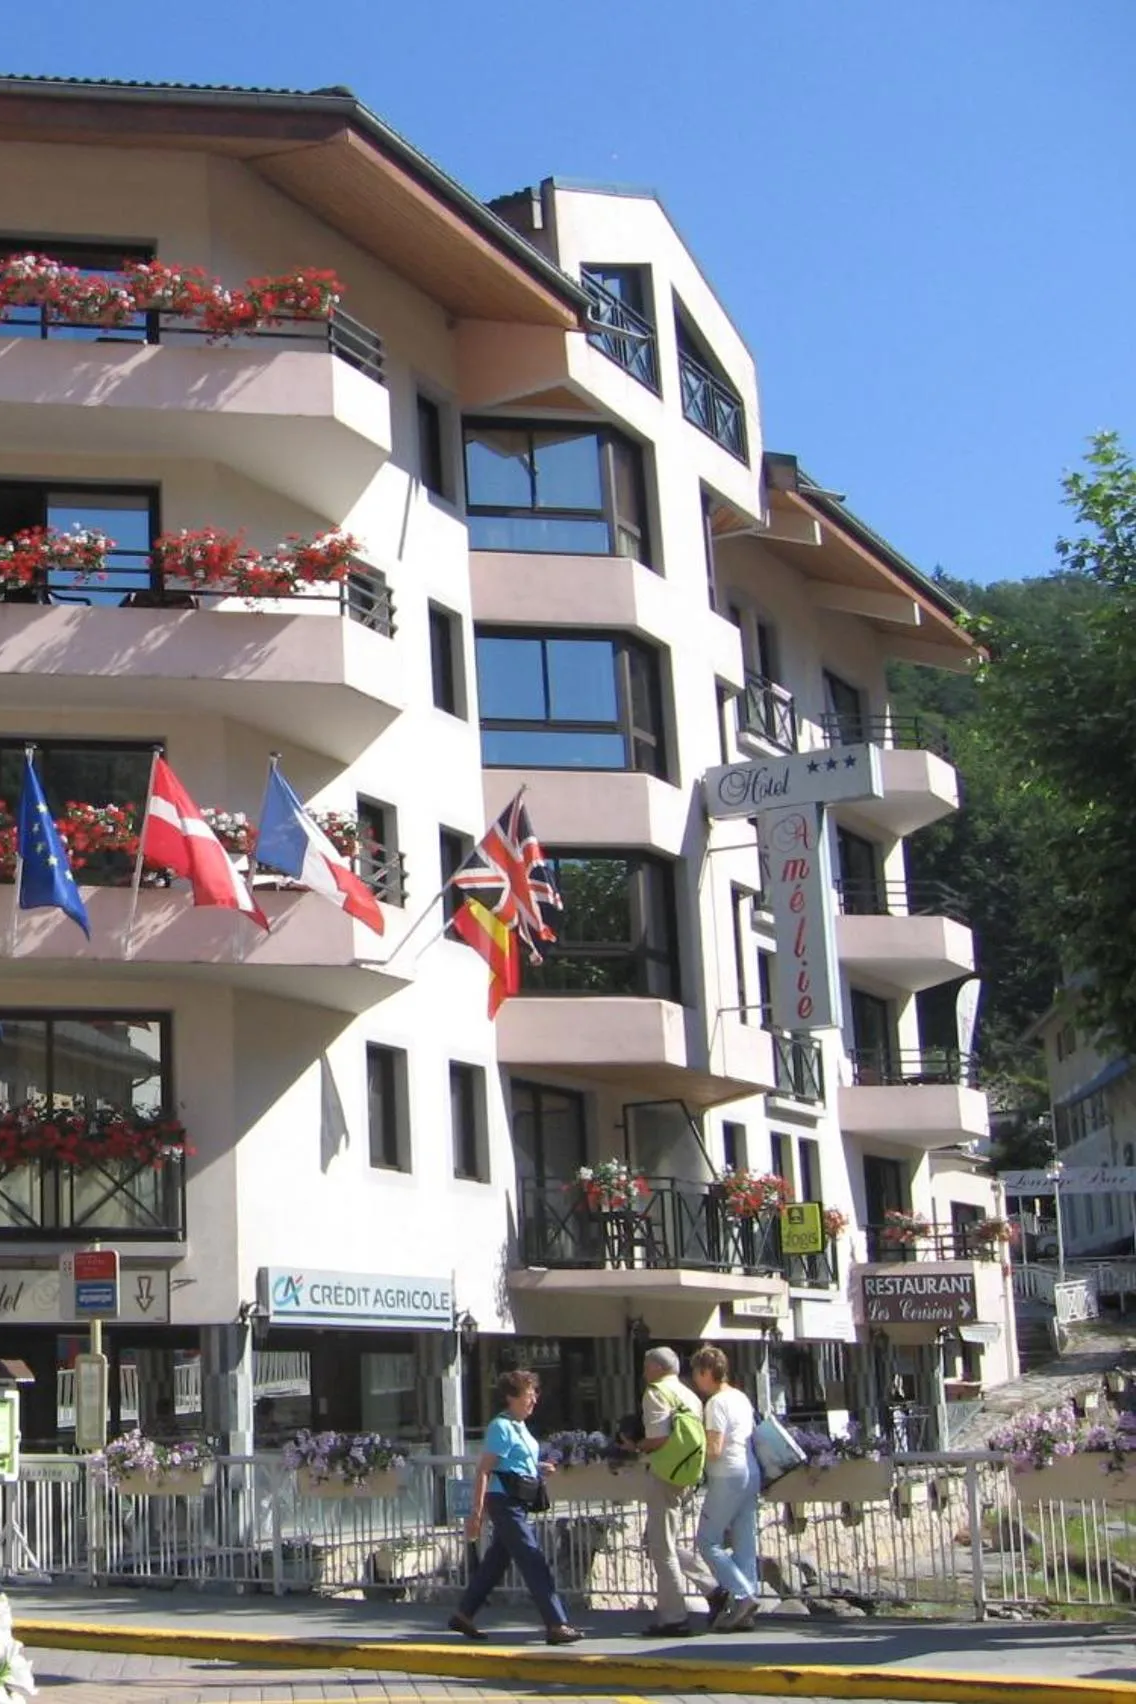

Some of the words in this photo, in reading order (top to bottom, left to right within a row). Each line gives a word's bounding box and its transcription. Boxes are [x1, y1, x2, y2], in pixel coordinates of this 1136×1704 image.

[770, 812, 813, 1019] Amélie
[310, 1281, 370, 1307] CRÉDIT
[372, 1287, 450, 1311] AGRICOLE
[864, 1276, 972, 1295] RESTAURANT
[868, 1299, 890, 1320] Les
